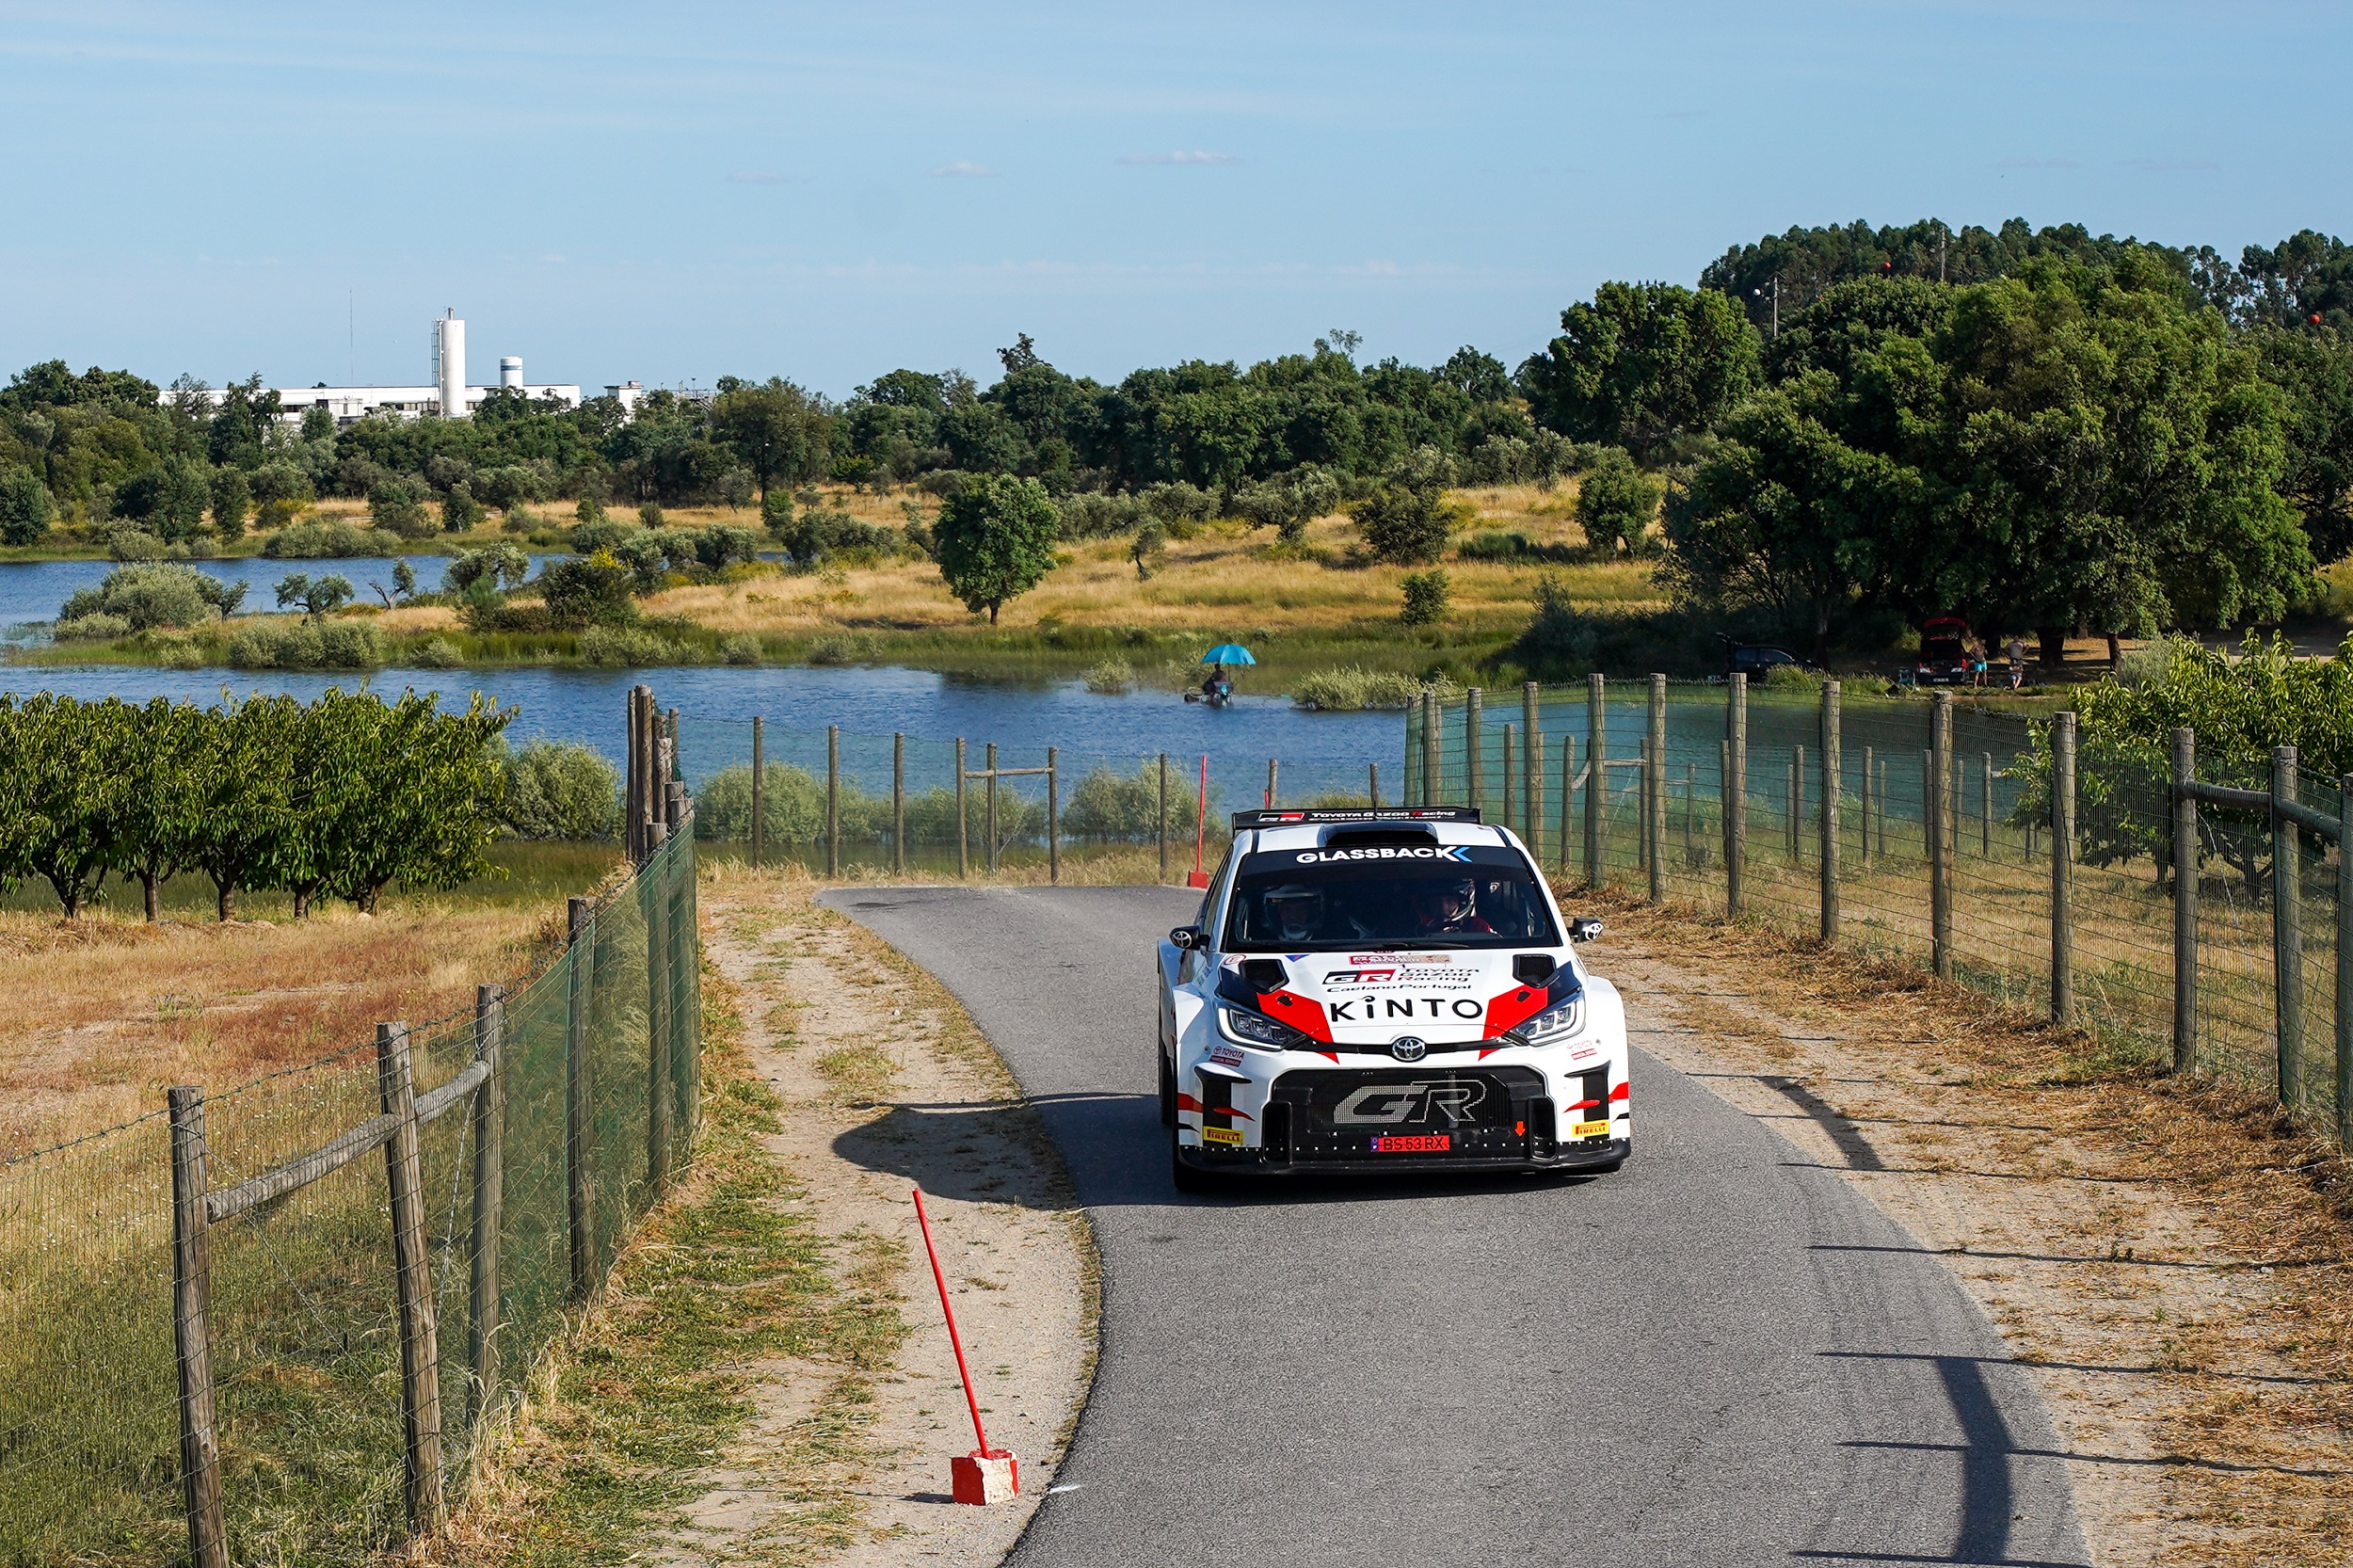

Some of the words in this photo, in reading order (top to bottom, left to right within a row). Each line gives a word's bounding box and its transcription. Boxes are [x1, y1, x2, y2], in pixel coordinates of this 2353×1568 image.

[1295, 846, 1460, 864] GLASSBACK
[1323, 971, 1393, 984] GR
[1223, 1048, 1245, 1060] TOYOTA
[1333, 1080, 1487, 1124] GR
[1207, 1128, 1241, 1142] PIRELLI
[1576, 1122, 1606, 1135] PIRELLI
[1383, 1138, 1403, 1150] BS
[1405, 1137, 1422, 1150] 53
[1424, 1137, 1444, 1150] RX
